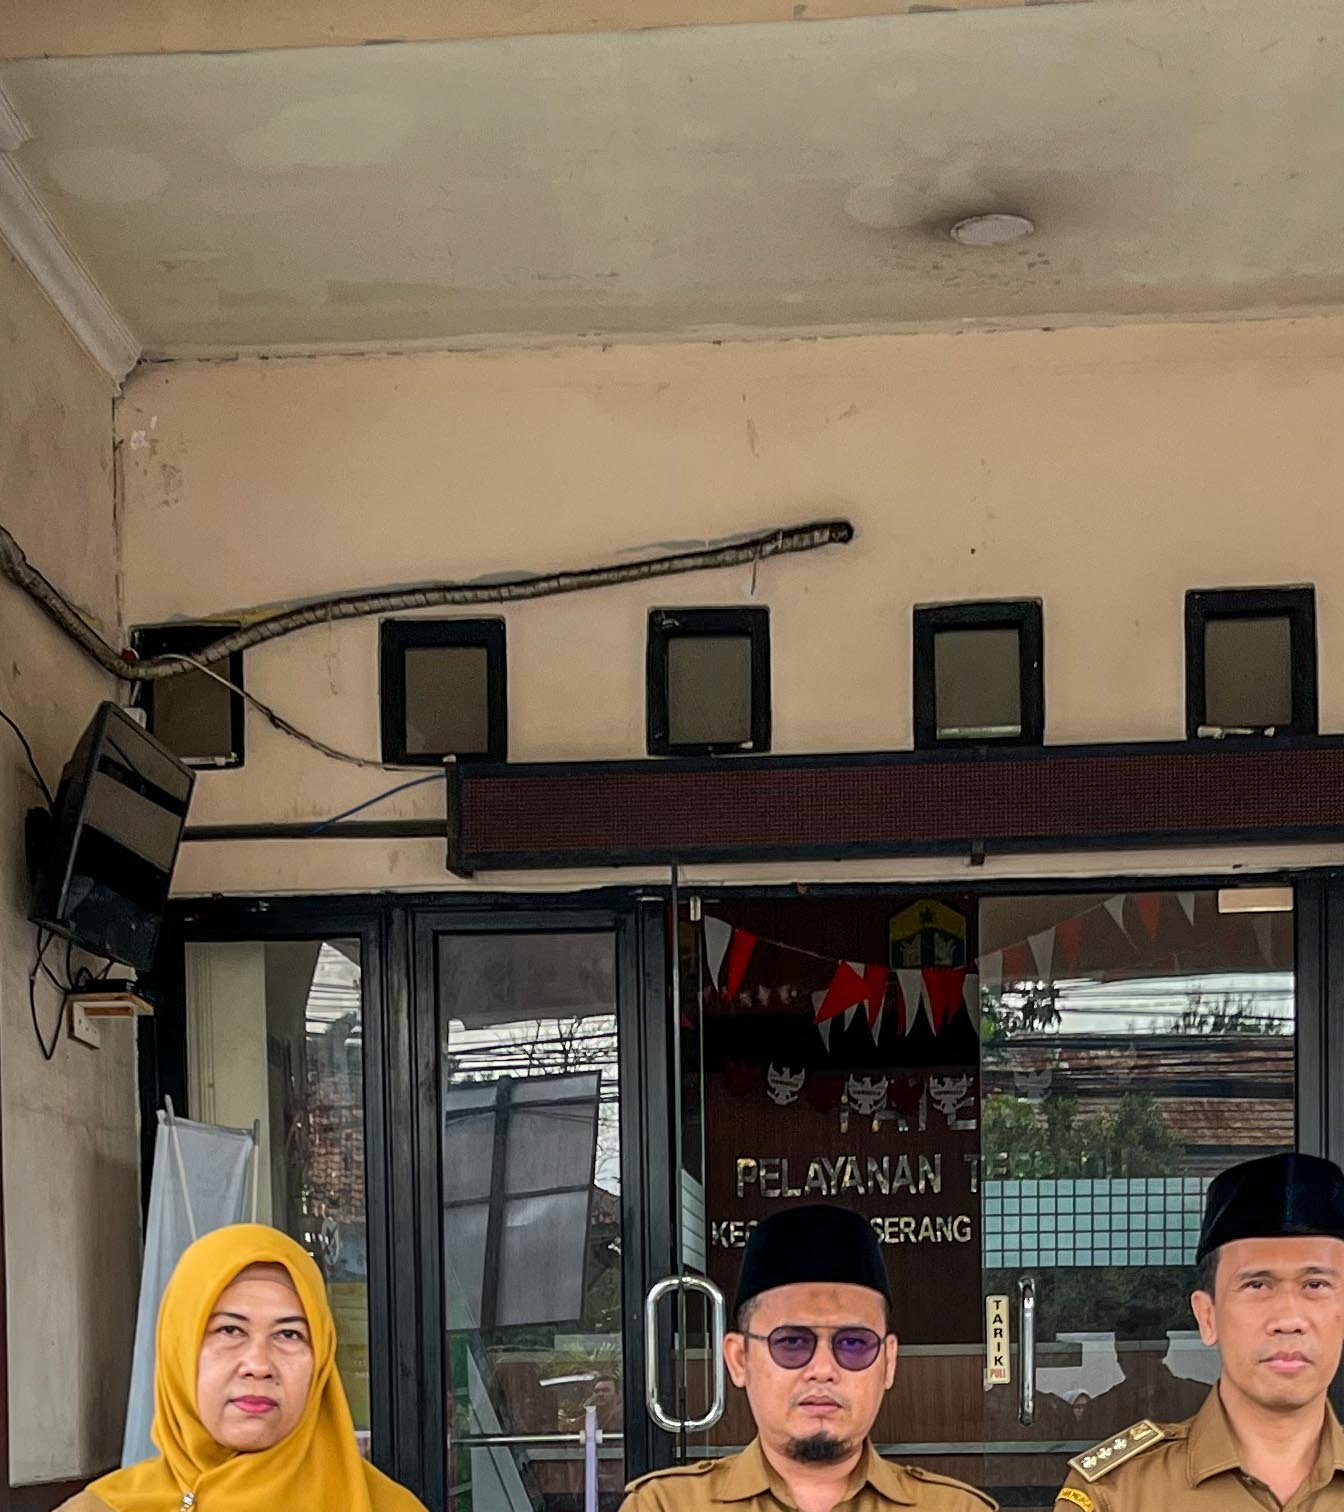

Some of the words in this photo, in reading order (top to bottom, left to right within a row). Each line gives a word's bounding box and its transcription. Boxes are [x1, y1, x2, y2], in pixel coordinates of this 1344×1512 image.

[736, 1154, 942, 1198] PELAYANAN
[870, 1216, 972, 1244] SERANG
[993, 1300, 1003, 1366] TARIK
